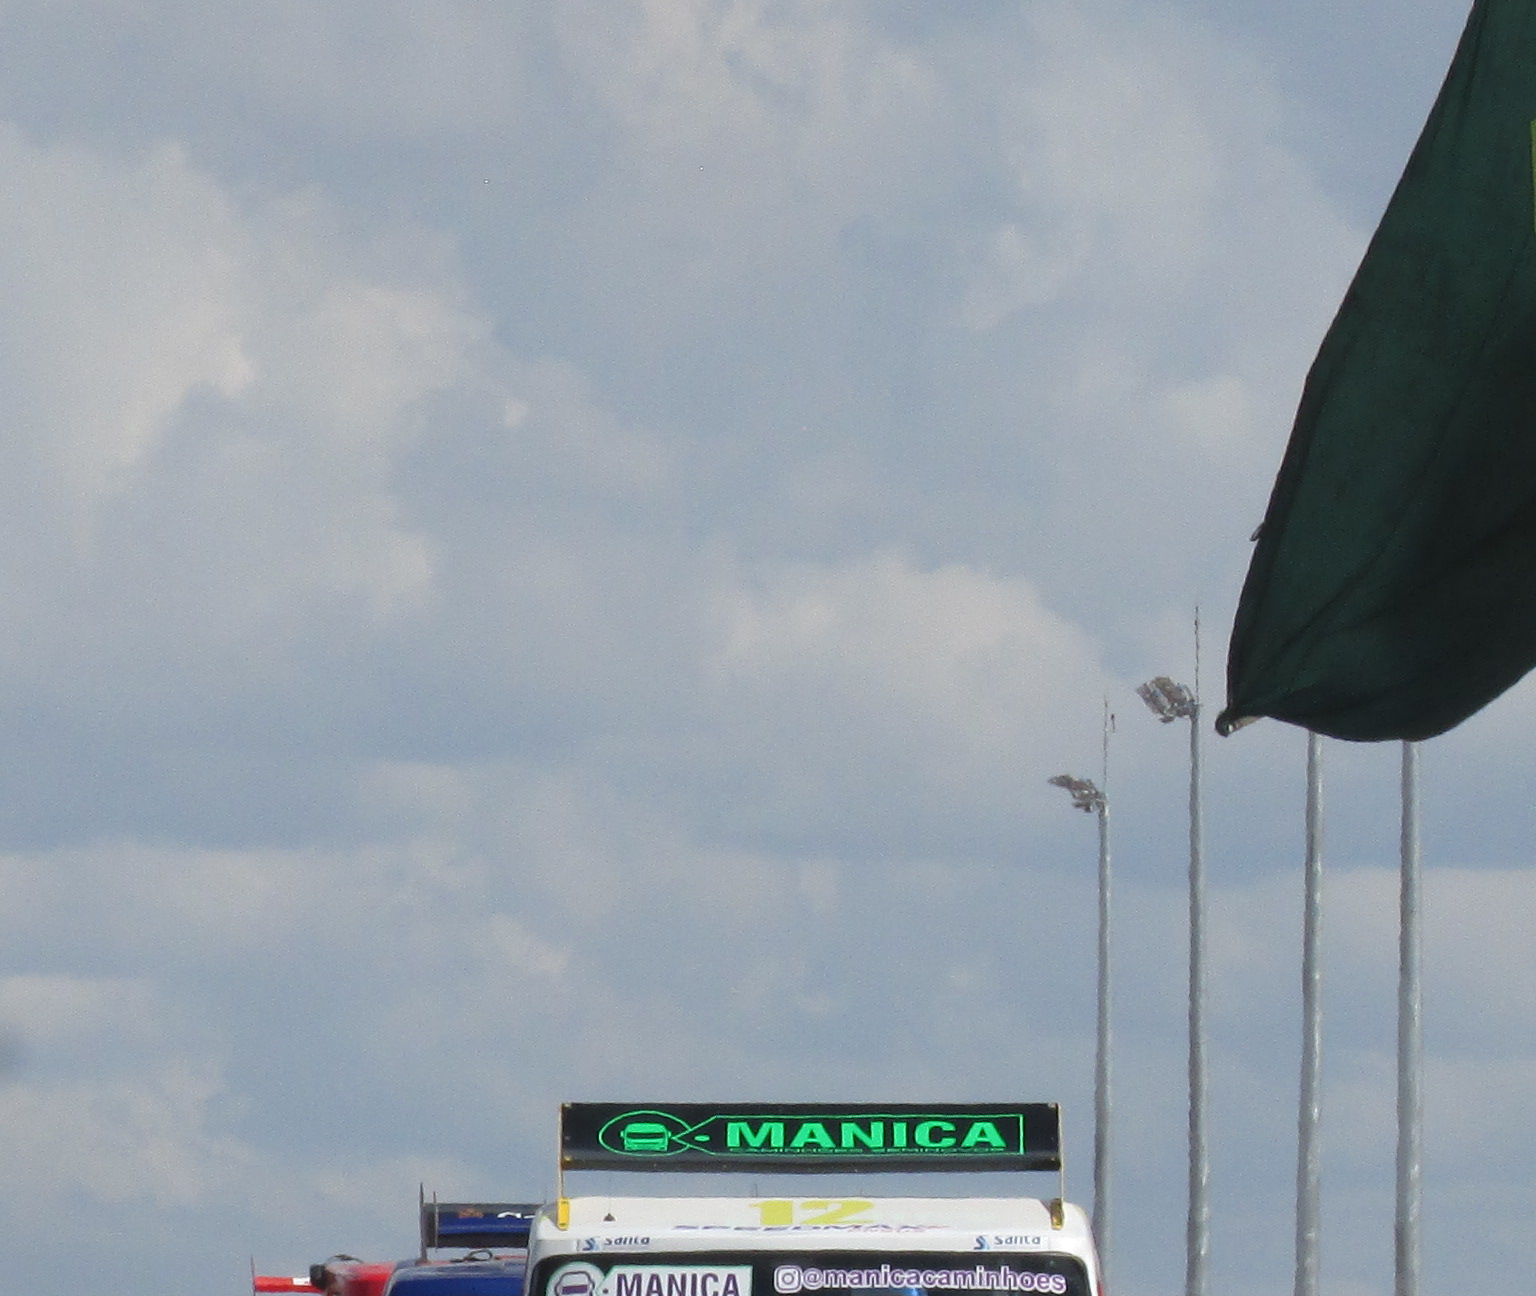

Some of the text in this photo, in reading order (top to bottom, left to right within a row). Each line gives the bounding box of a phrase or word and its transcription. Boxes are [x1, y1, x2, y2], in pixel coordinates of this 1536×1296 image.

[726, 1121, 1007, 1148] MANICA
[748, 1200, 875, 1226] 12
[801, 1264, 1068, 1294] @manicacaminhoes
